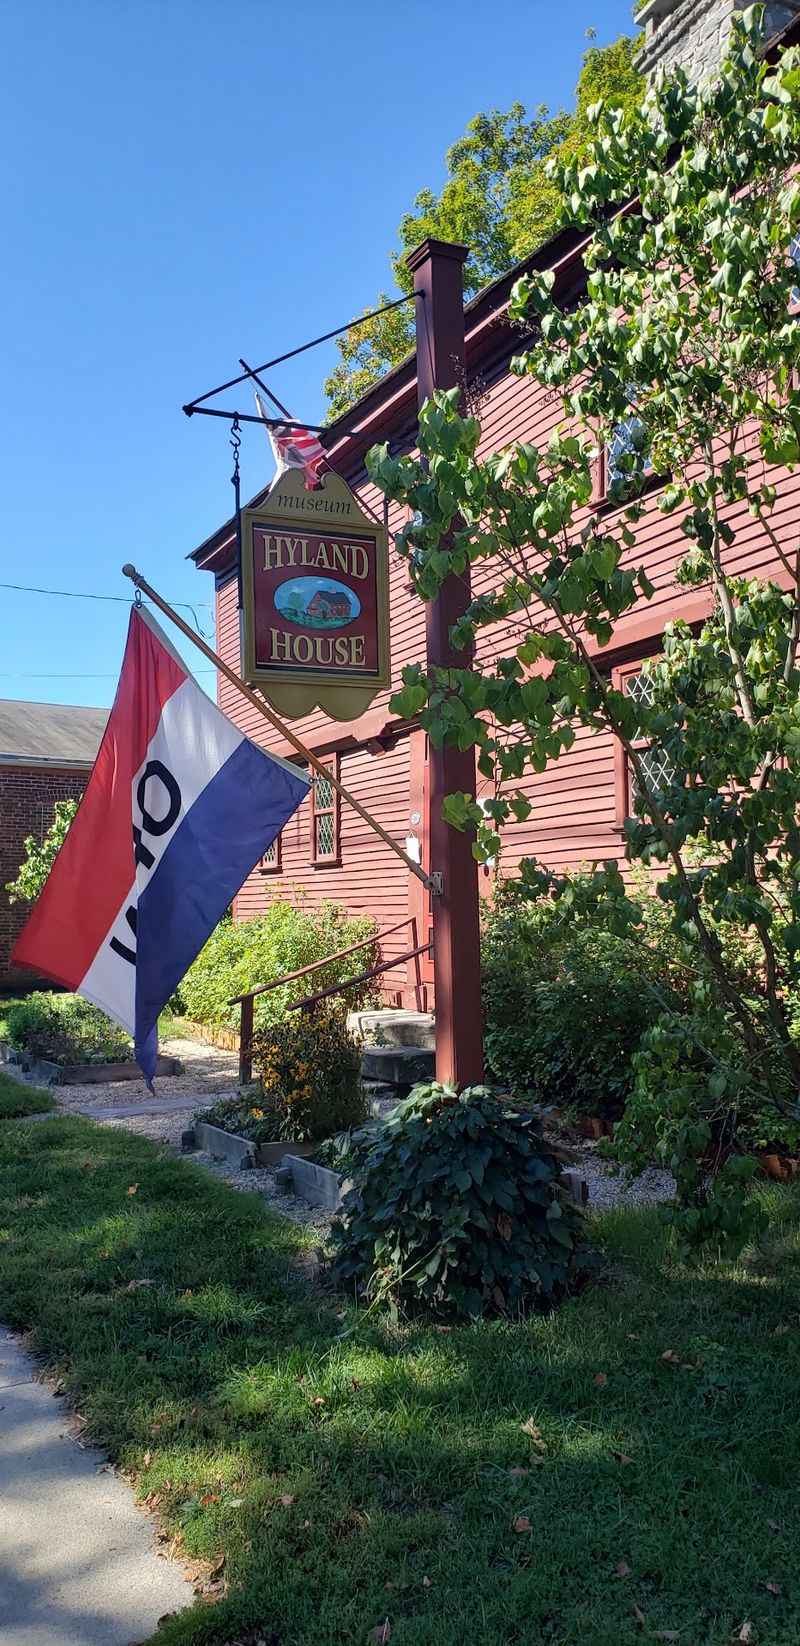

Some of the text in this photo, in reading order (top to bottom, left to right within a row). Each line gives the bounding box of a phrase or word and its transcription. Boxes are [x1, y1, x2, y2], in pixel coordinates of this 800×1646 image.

[276, 495, 351, 514] museum
[262, 534, 369, 579] HYLAND
[269, 627, 366, 666] HOUSE
